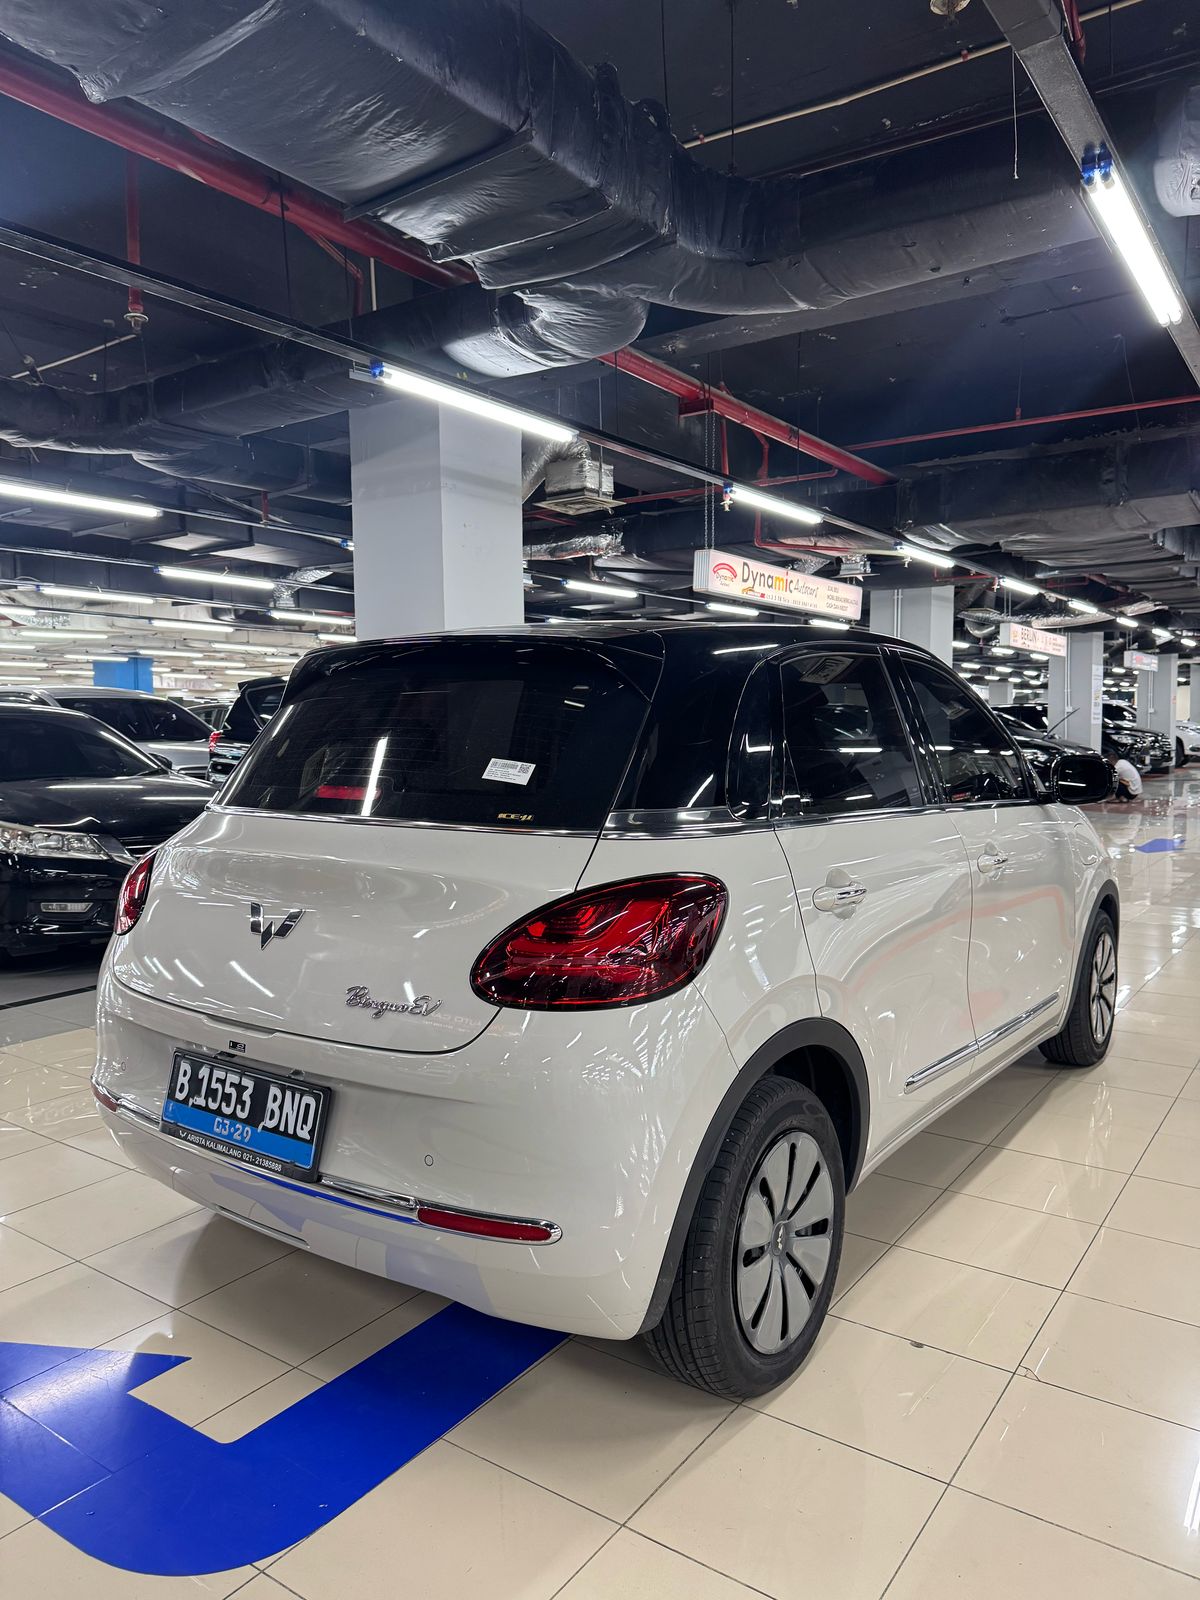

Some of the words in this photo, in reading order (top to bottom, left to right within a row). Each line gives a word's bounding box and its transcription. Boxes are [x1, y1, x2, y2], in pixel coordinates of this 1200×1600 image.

[742, 561, 793, 593] Dynamic
[175, 1060, 192, 1100] B
[196, 1064, 255, 1120] 1553
[264, 1084, 316, 1140] BNQ
[187, 1133, 206, 1146] ARISTA
[206, 1140, 242, 1158] KALIMALANG
